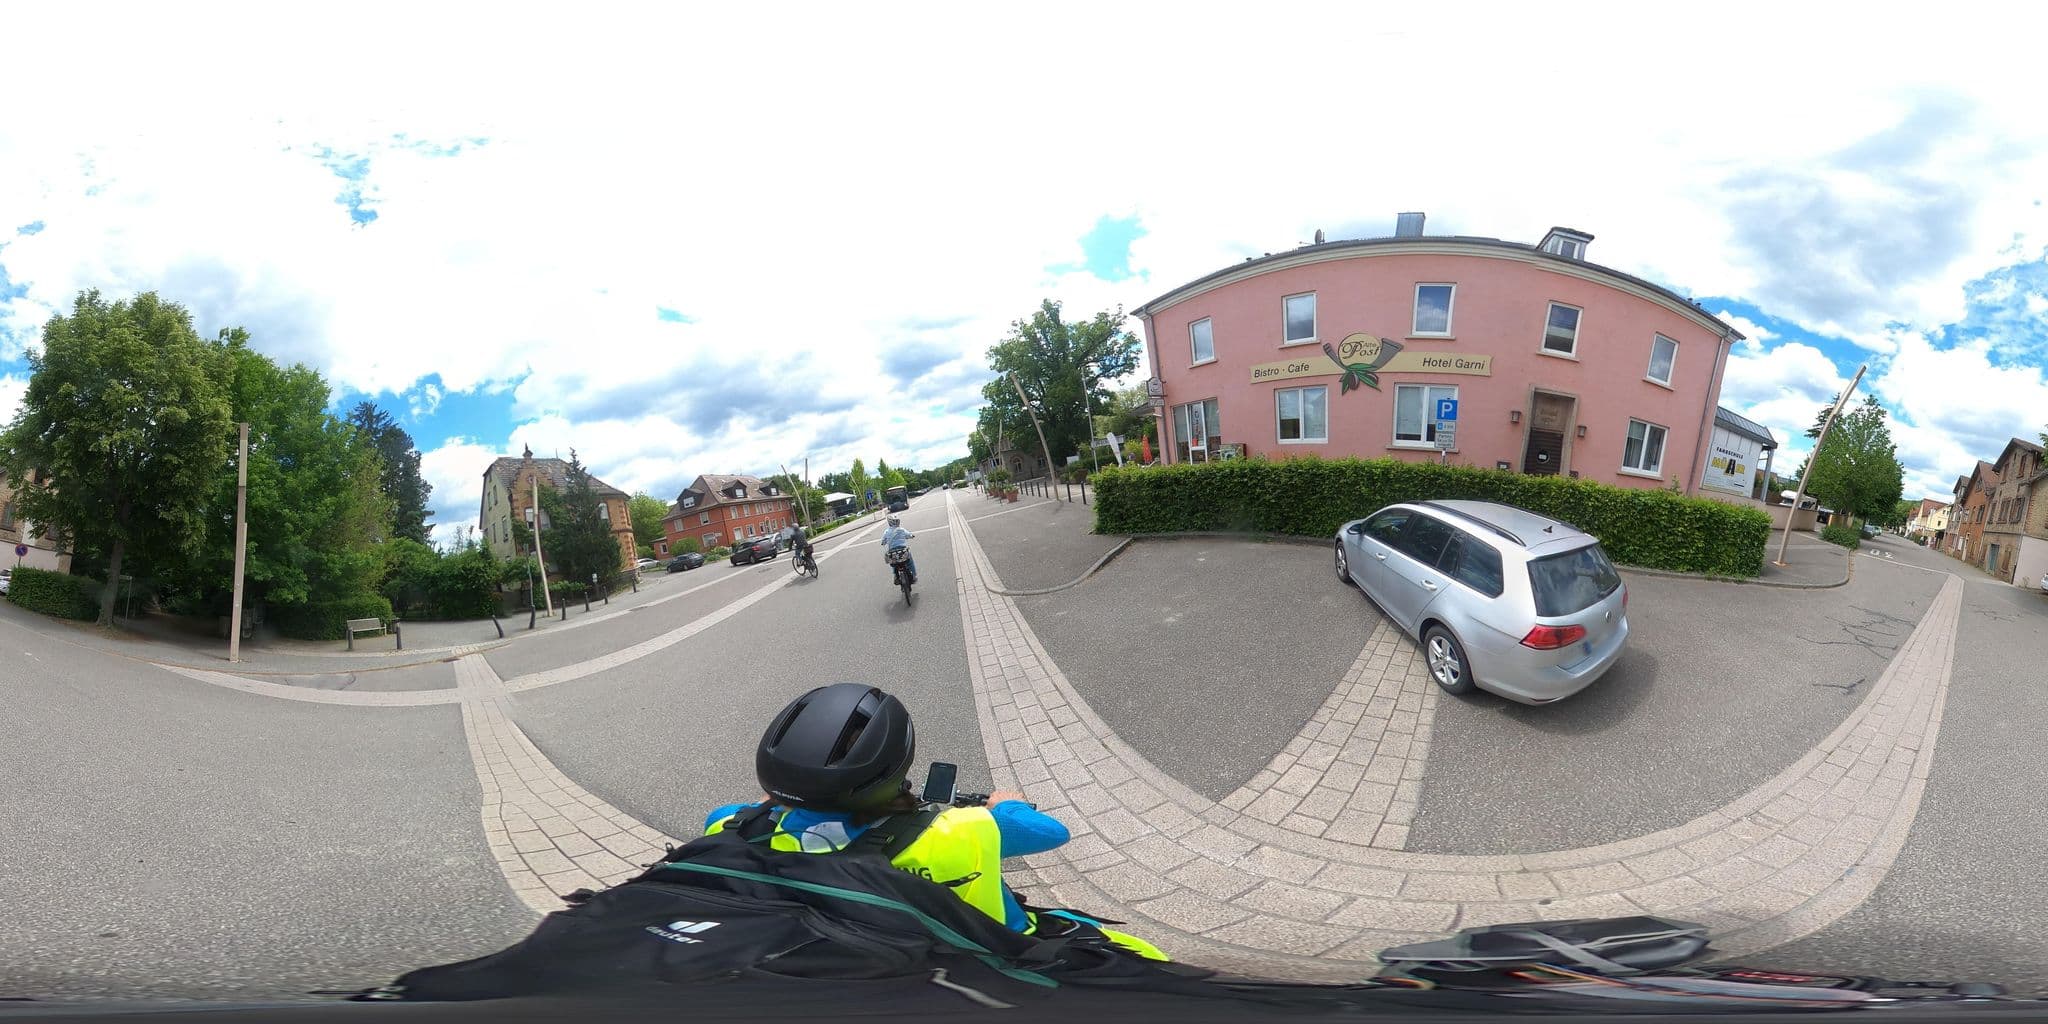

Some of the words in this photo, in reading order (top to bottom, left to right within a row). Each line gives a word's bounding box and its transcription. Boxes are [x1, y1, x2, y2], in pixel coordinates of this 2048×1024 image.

[1342, 340, 1380, 359] Post
[1254, 368, 1279, 378] Bistro
[1287, 362, 1310, 374] Cafe
[1422, 357, 1452, 368] Hotel
[1455, 358, 1485, 370] Garni
[1441, 402, 1453, 418] P
